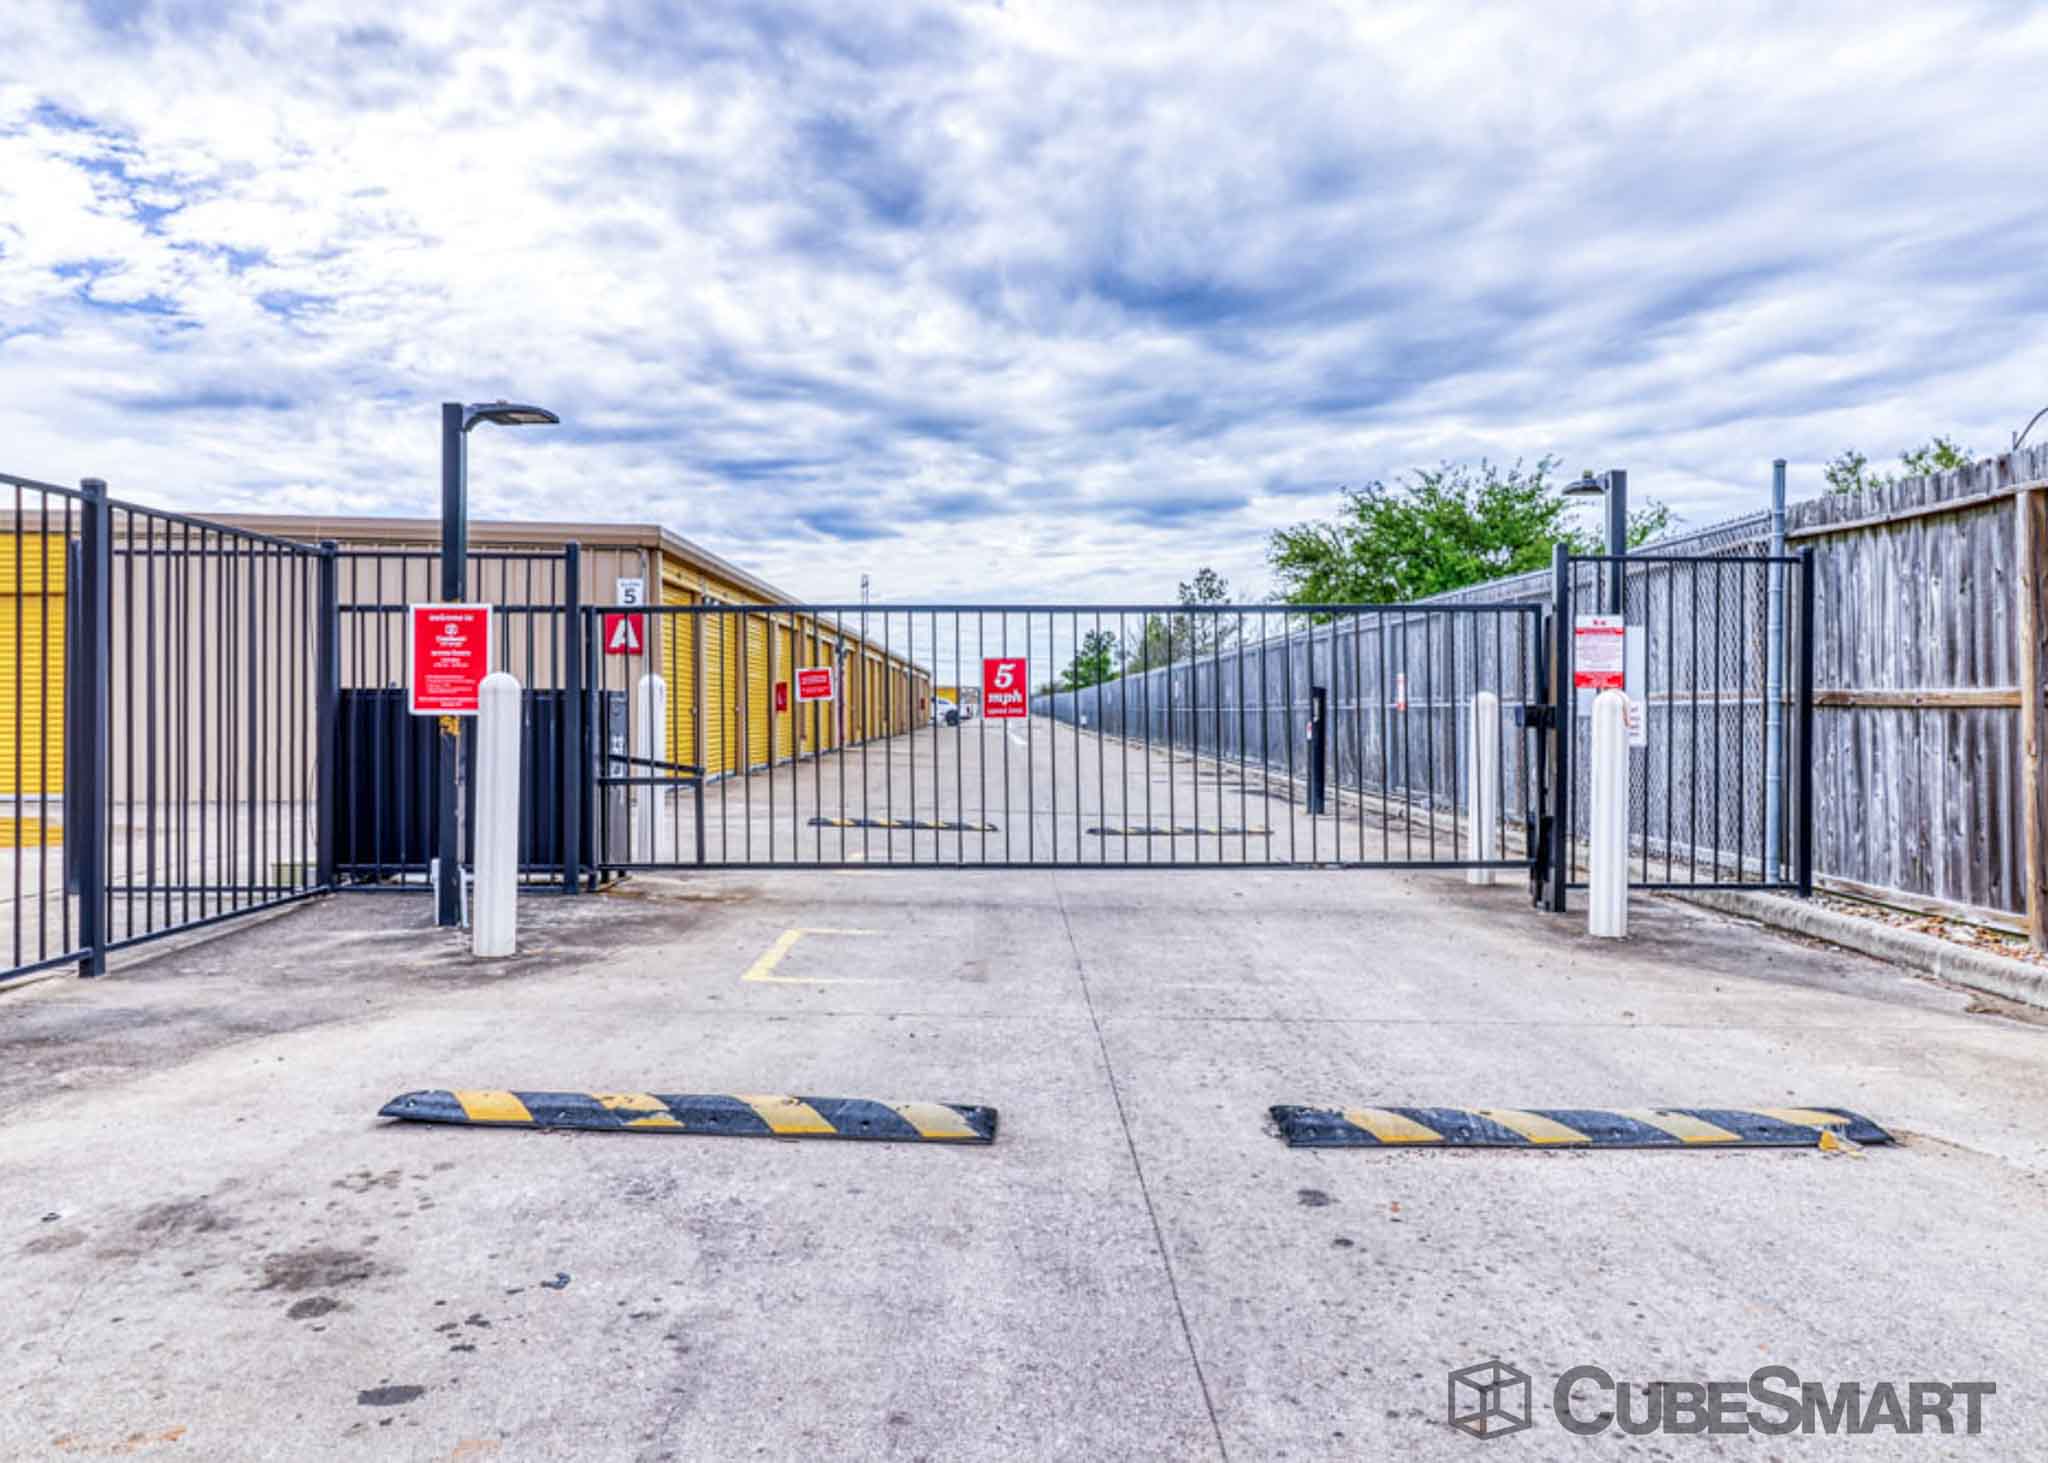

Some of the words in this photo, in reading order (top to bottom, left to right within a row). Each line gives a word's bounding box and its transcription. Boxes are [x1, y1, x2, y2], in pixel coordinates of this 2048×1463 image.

[624, 588, 637, 604] 5
[609, 617, 640, 649] A
[994, 663, 1017, 689] 5
[988, 688, 1023, 706] mph
